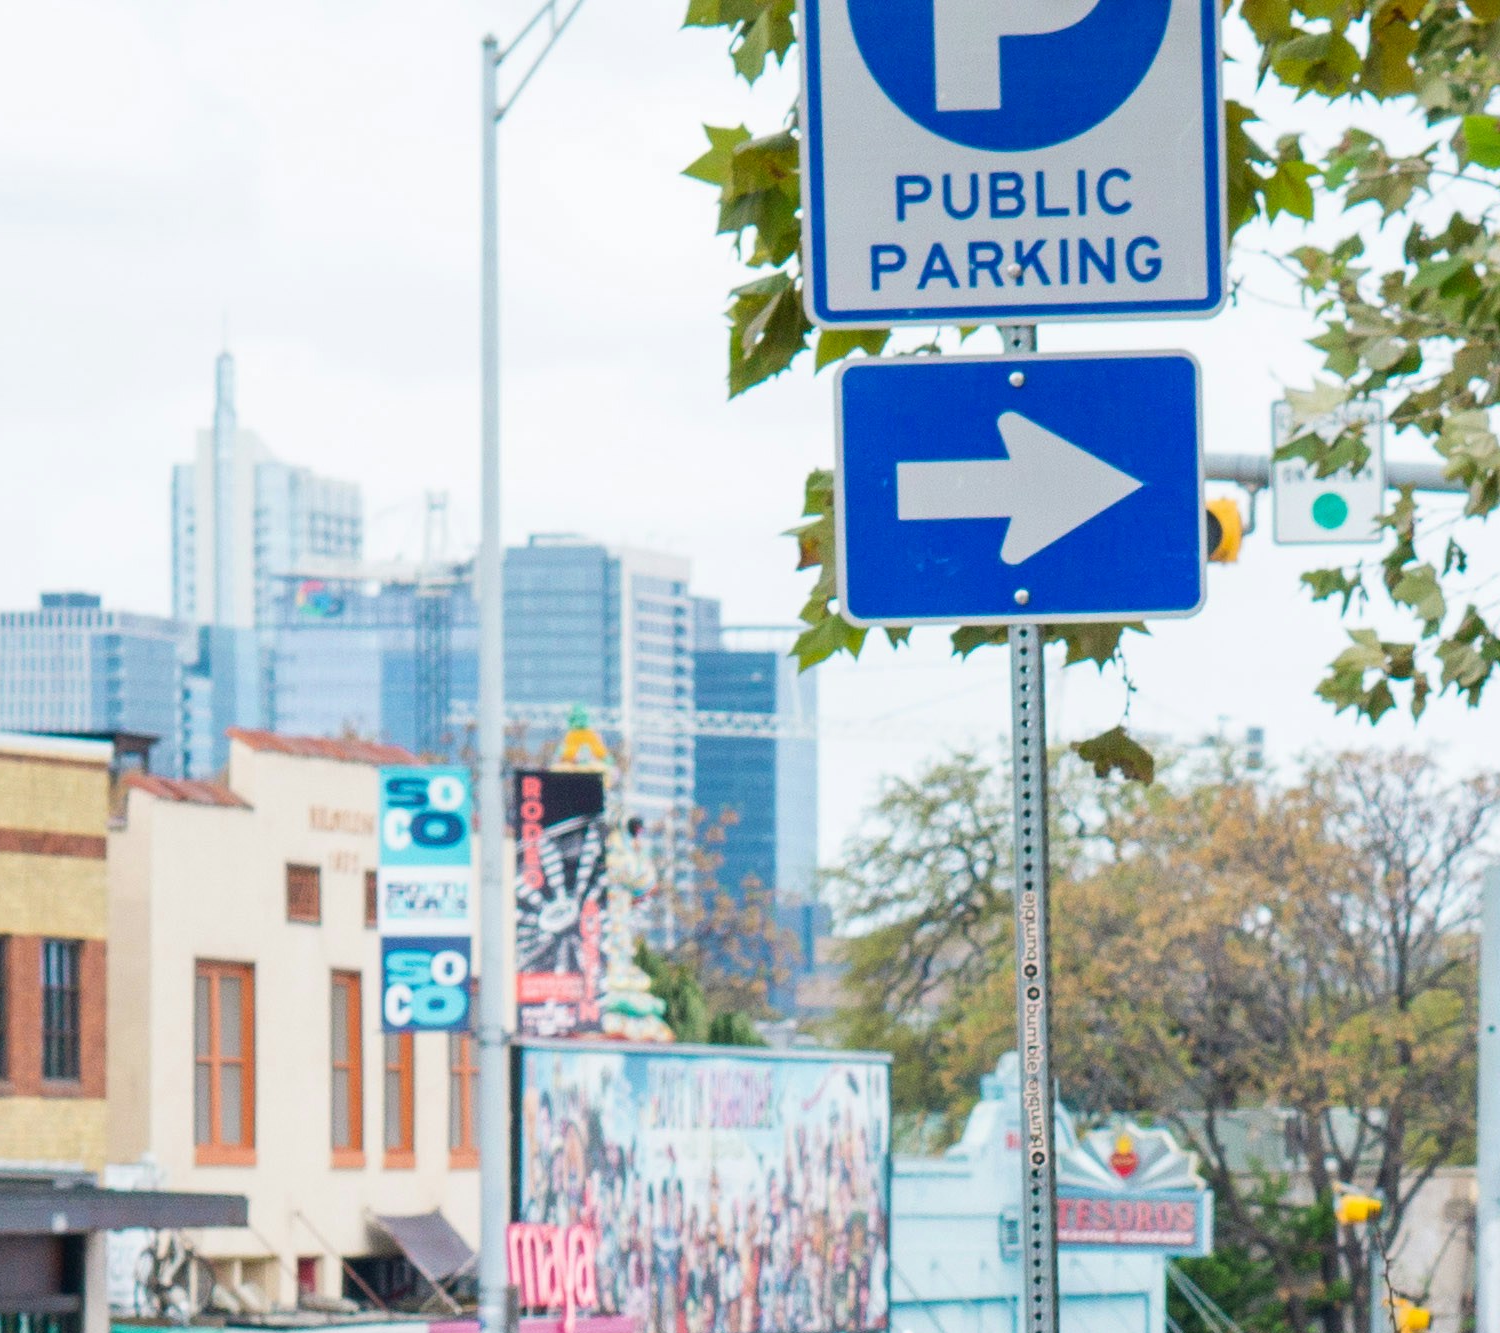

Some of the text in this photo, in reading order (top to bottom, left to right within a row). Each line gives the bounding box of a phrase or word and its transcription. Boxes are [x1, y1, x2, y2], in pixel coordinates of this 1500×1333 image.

[896, 167, 1133, 222] PUBLIC
[870, 235, 1164, 292] PARKING
[1021, 892, 1038, 962] bumble
[1025, 1002, 1042, 1072] bumble
[1029, 1080, 1045, 1150] bumble
[1057, 1200, 1189, 1231] TESOROS
